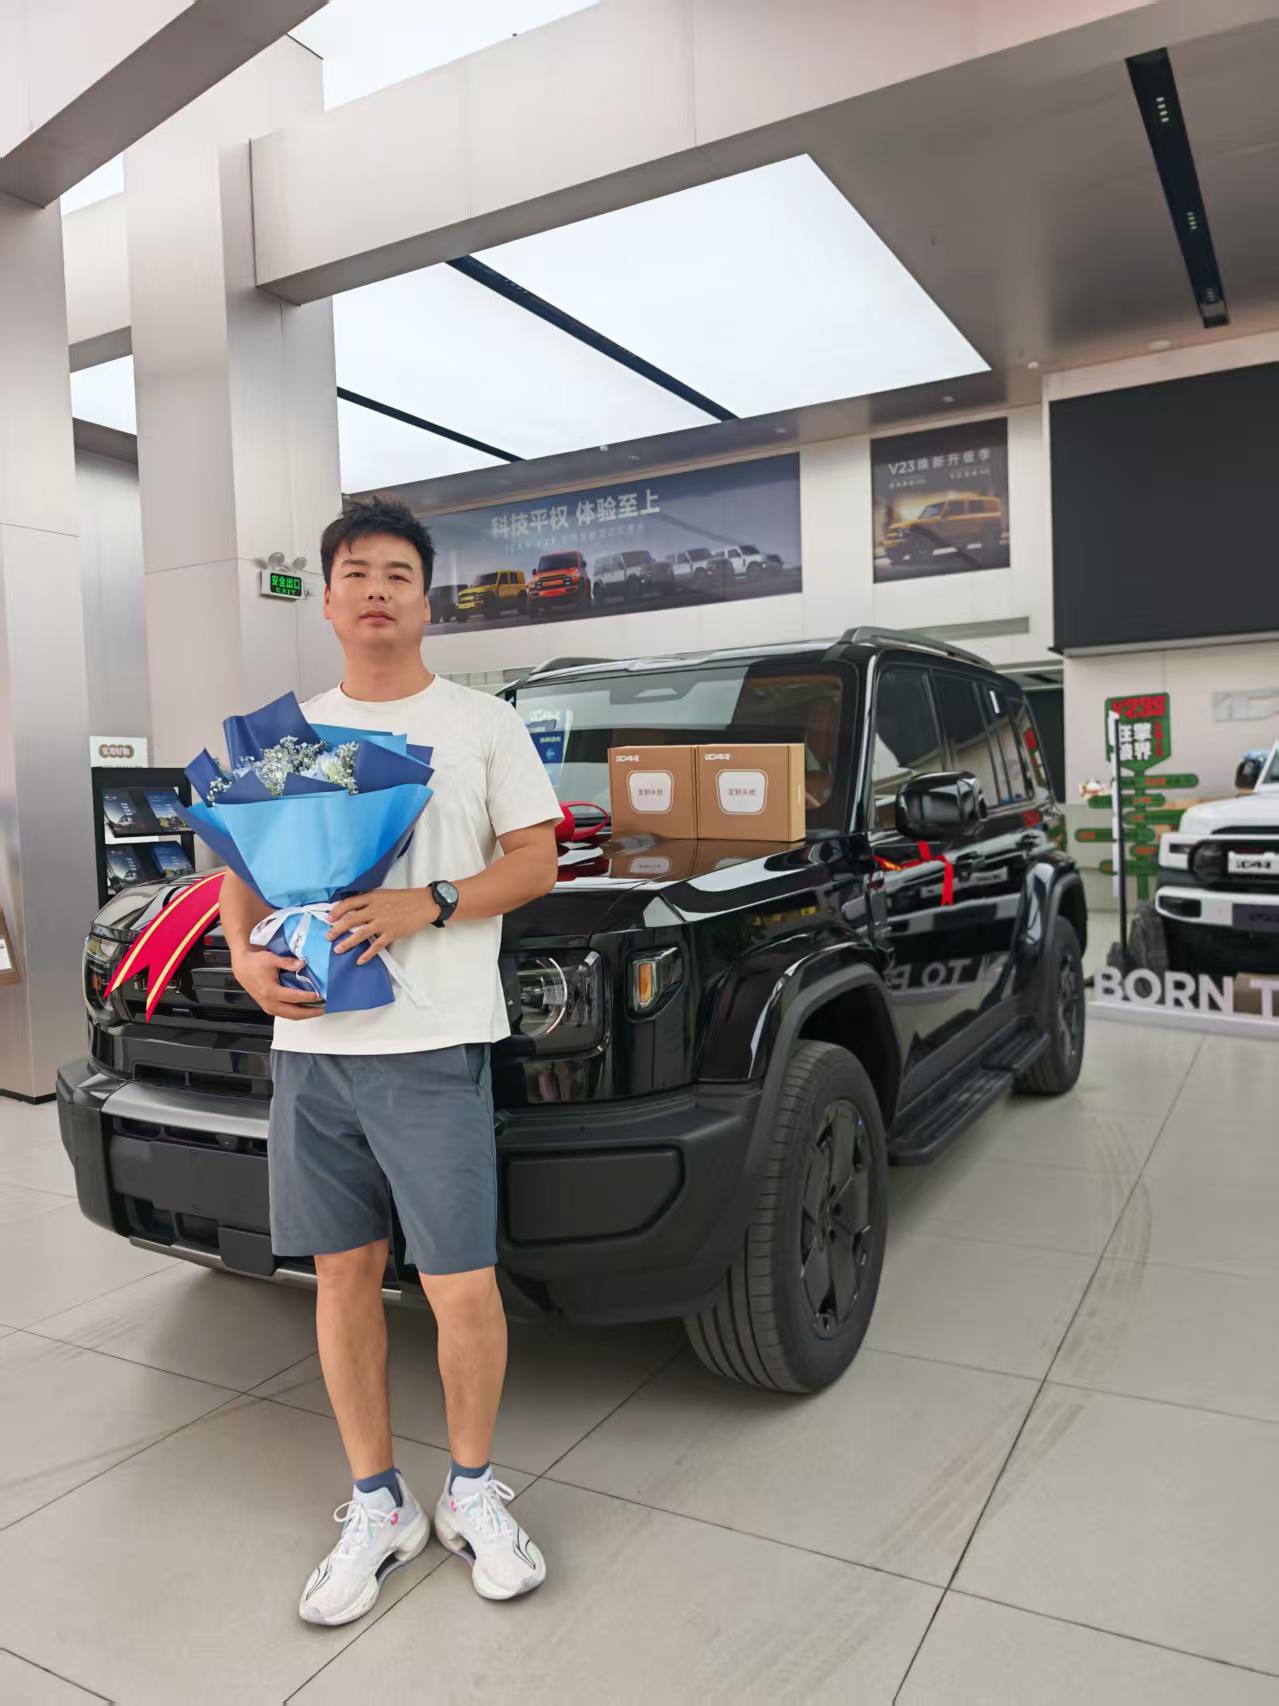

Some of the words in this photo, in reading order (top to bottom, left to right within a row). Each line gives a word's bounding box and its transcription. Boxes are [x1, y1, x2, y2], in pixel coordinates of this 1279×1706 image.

[491, 506, 569, 539] 科技平权
[576, 489, 661, 526] 体验至上
[271, 574, 301, 590] 安全出口
[275, 587, 297, 596] EXIT
[1093, 965, 1235, 1016] BORN
[1249, 978, 1279, 1019] T
